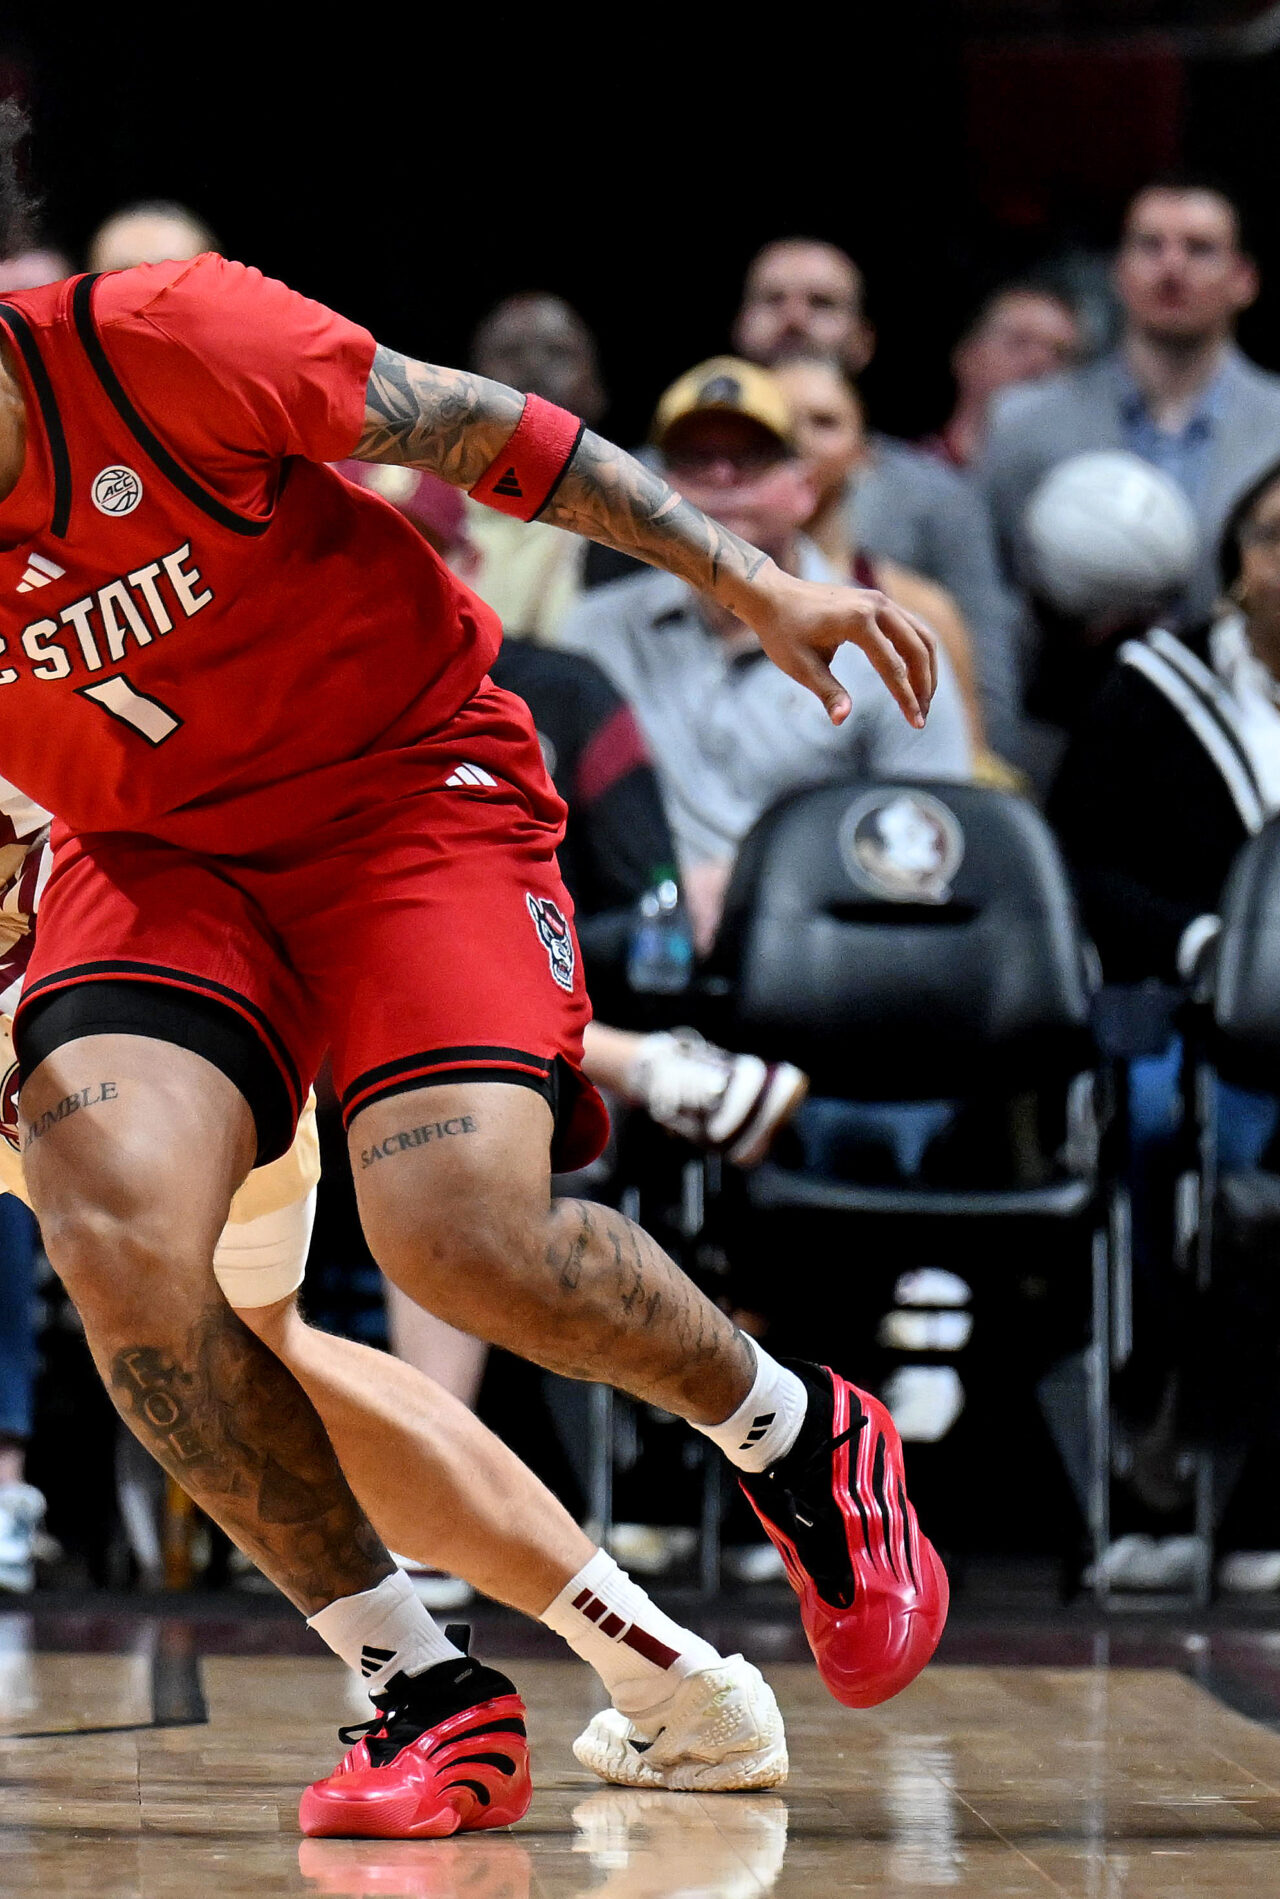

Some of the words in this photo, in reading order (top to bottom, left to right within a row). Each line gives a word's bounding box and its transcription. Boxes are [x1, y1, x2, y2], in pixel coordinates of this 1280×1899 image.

[102, 474, 134, 501] ACC
[21, 541, 214, 682] STATE
[73, 672, 185, 749] 1
[360, 1114, 478, 1170] SACRIFICE
